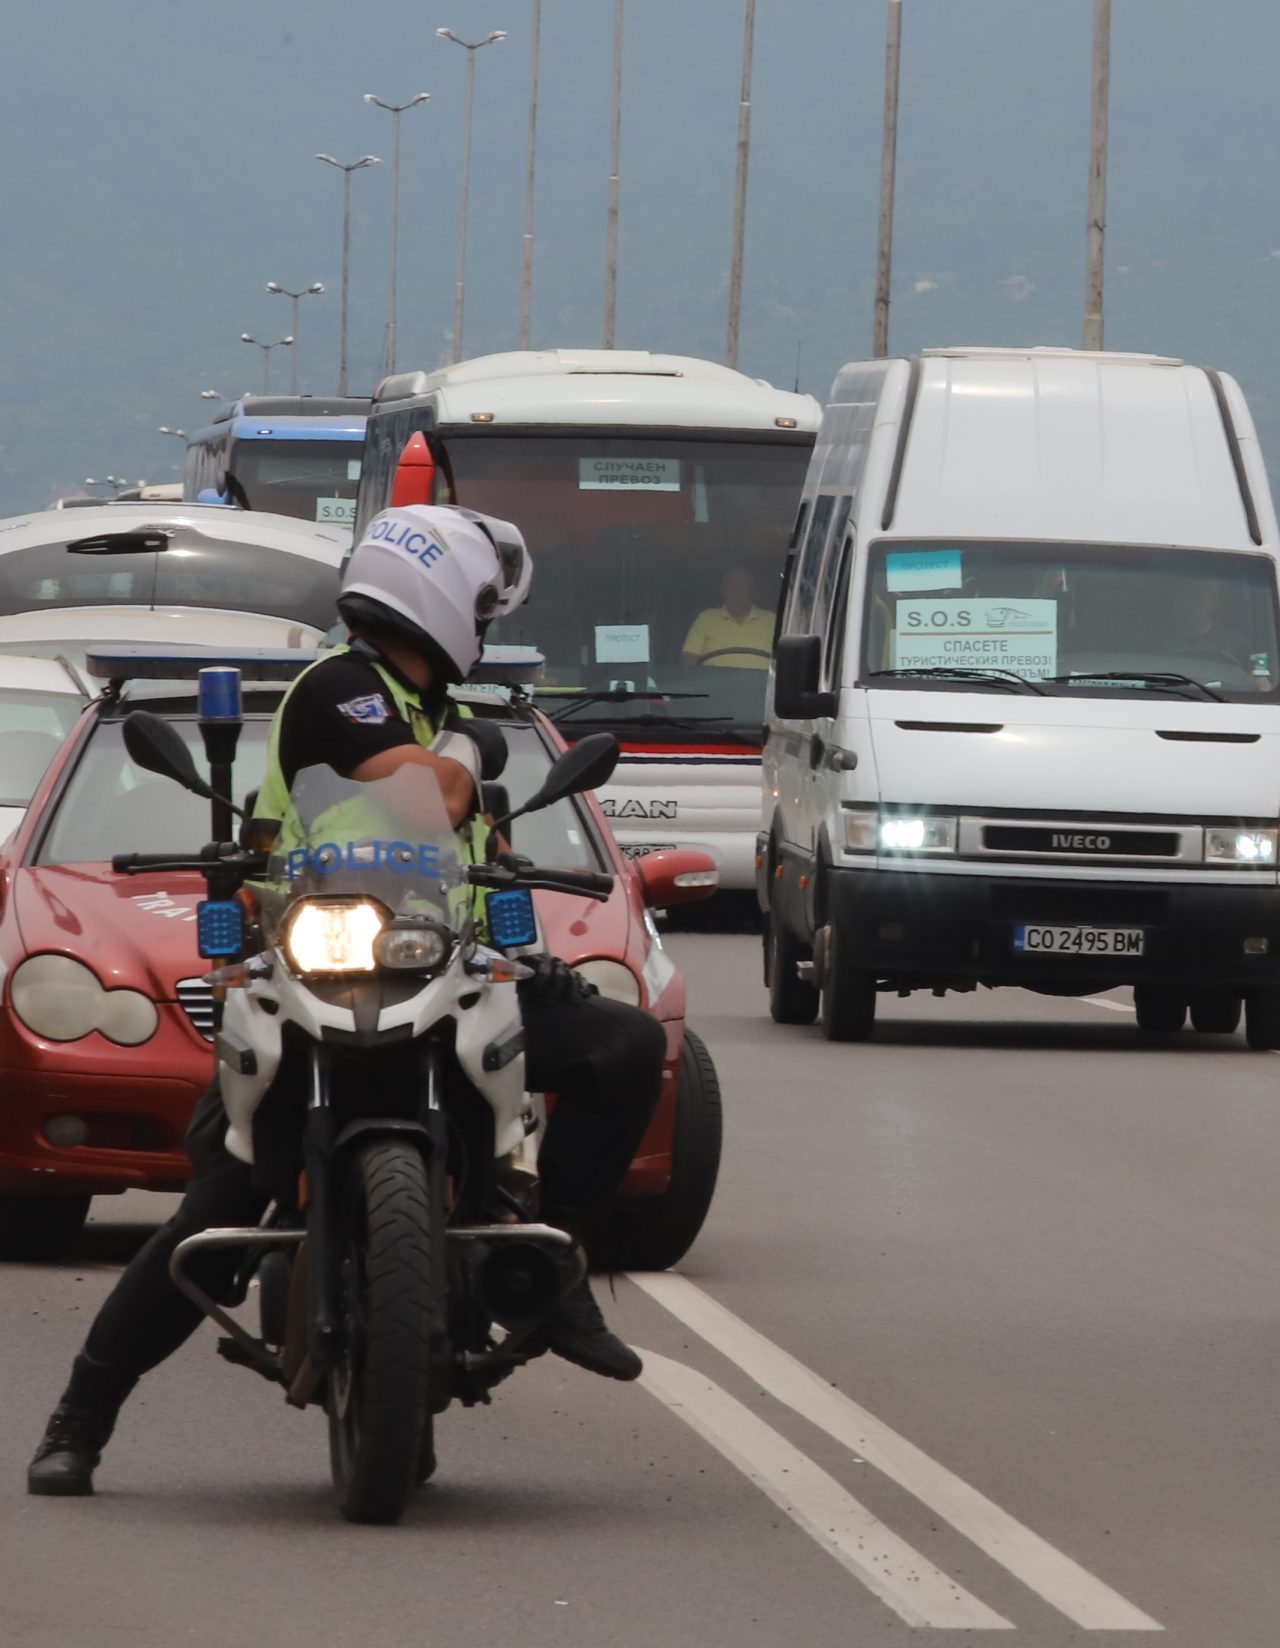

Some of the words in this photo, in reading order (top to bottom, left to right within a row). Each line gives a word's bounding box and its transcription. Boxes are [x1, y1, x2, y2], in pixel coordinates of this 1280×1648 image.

[593, 462, 666, 473] СЛУЧАЕН
[598, 474, 662, 485] ПРЕВОЗ
[907, 610, 971, 628] S.O.S
[943, 640, 1008, 653] СПАСЕТЕ
[899, 655, 998, 667] ТУРИСТИЧЕСКИЯ
[1052, 833, 1111, 850] IVECO
[287, 839, 441, 882] POLICE
[1059, 930, 1109, 952] 2495
[1114, 932, 1141, 953] BM
